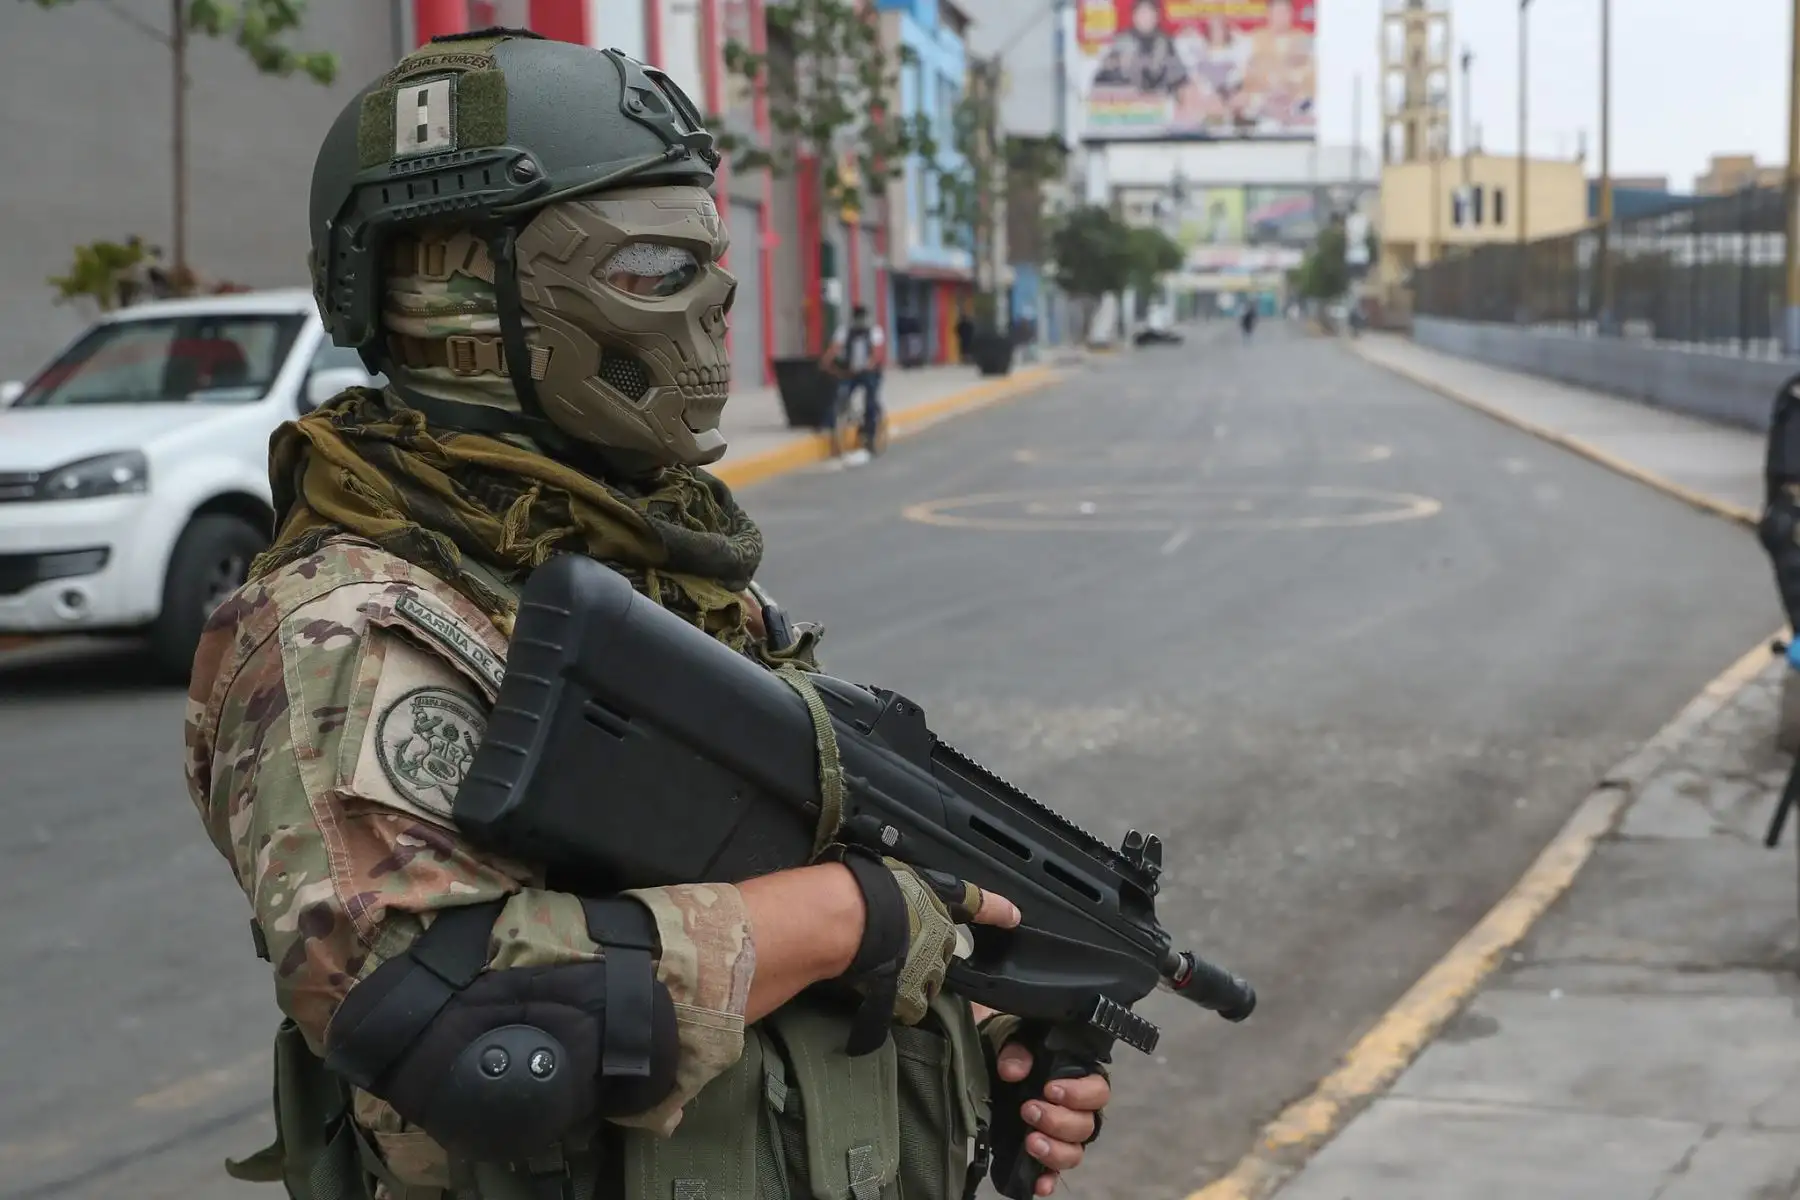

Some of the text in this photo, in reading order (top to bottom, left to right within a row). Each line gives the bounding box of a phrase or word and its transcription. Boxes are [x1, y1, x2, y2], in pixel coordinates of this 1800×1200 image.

[440, 55, 490, 69] FORCES
[405, 602, 469, 651] MARINA
[472, 648, 494, 670] DE
